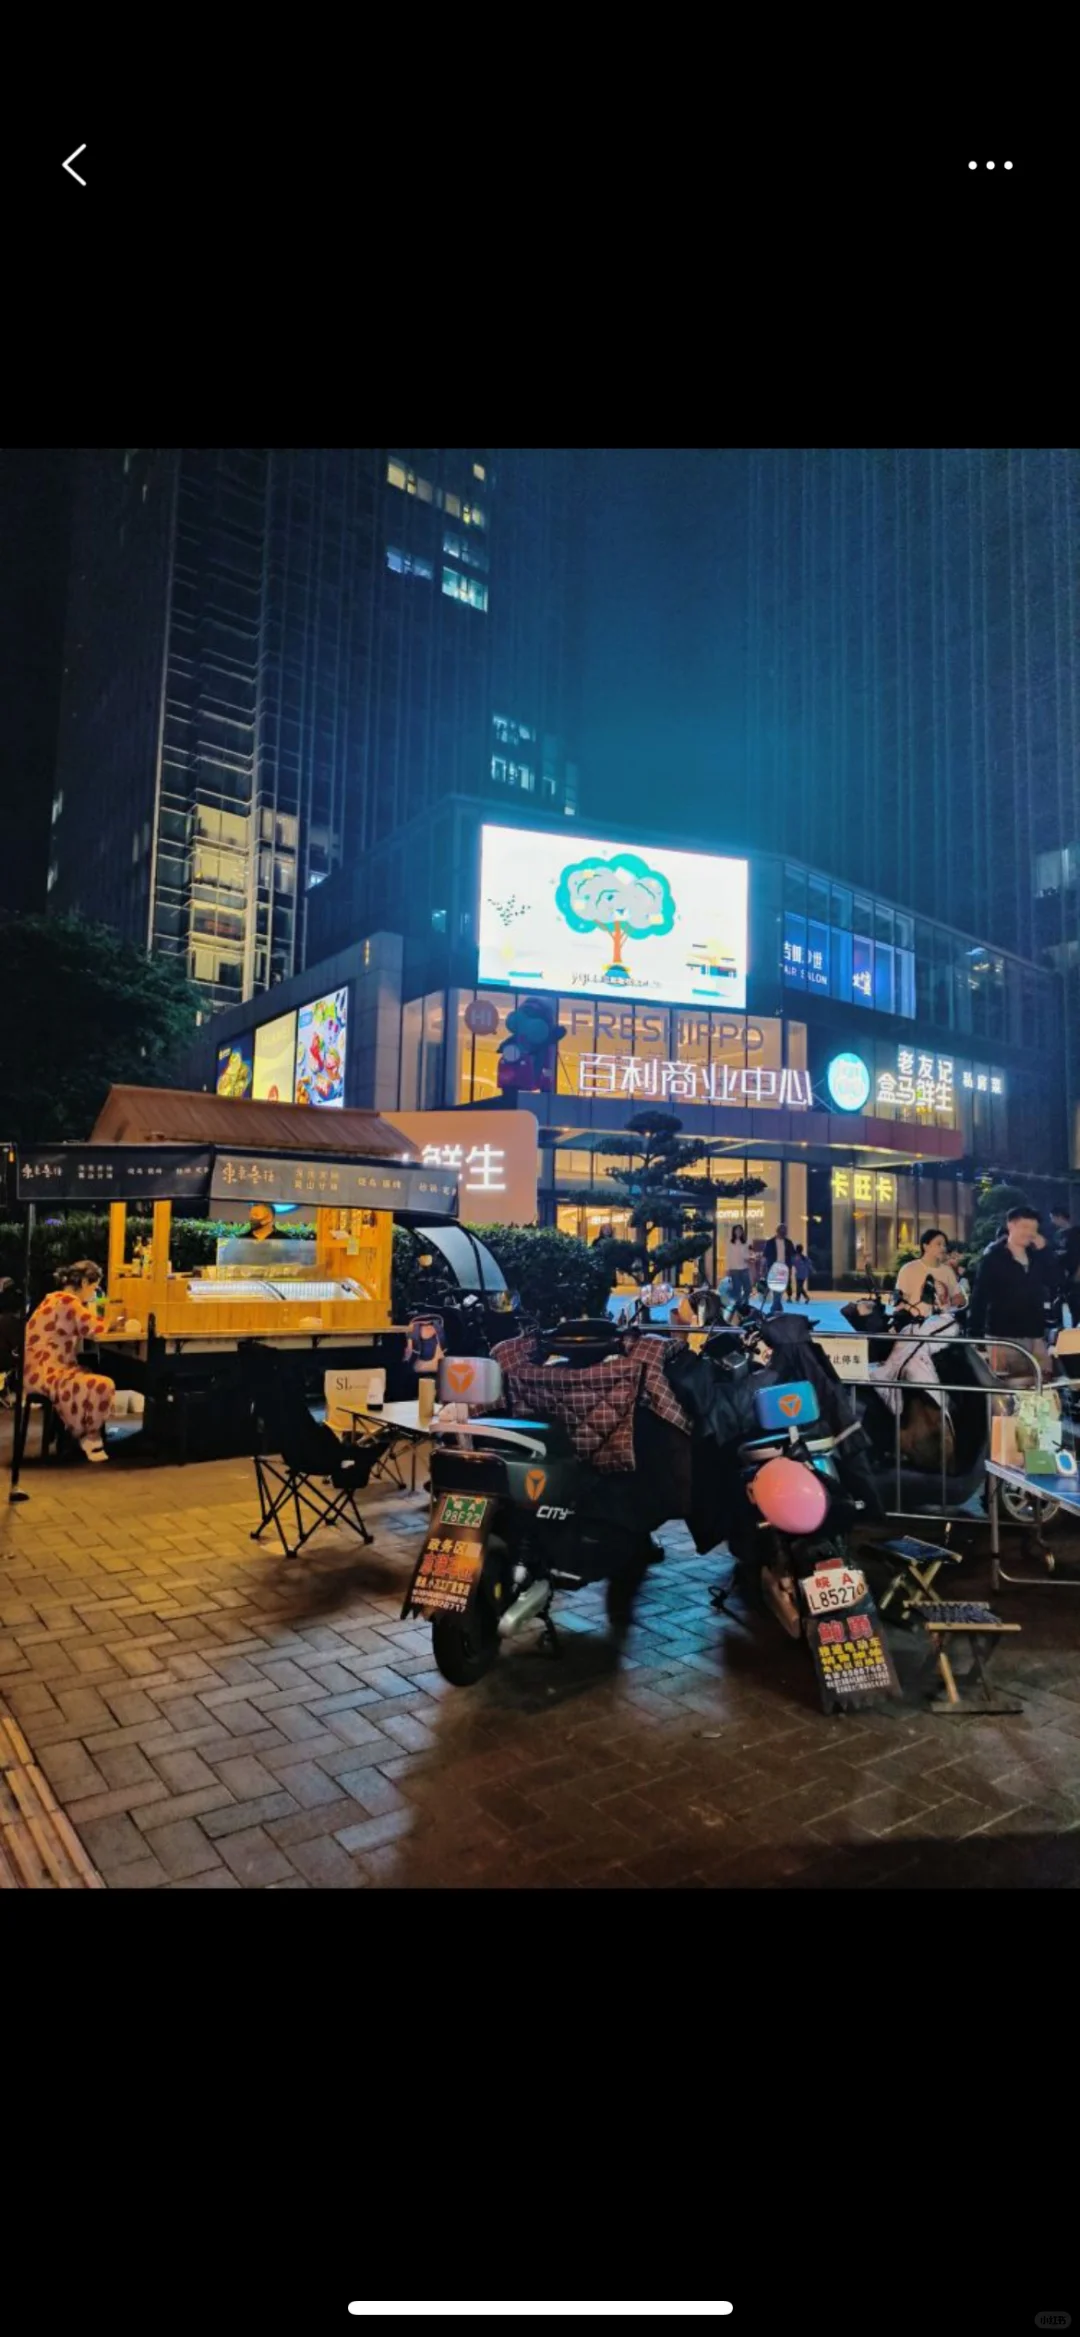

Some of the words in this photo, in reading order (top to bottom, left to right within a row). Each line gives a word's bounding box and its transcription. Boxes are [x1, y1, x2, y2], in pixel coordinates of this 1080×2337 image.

[470, 1010, 493, 1026] HI
[571, 1008, 764, 1051] FRESHIPPO
[578, 1052, 814, 1107] 百利商业中心
[897, 1050, 954, 1084] 老友记
[876, 1071, 954, 1113] 盒马鲜生
[831, 1170, 893, 1203] 卡旺卡
[827, 1353, 861, 1365] 止停车
[536, 1505, 572, 1520] CITY
[815, 1576, 831, 1589] 皖
[842, 1572, 854, 1585] A
[808, 1583, 865, 1611] L85270
